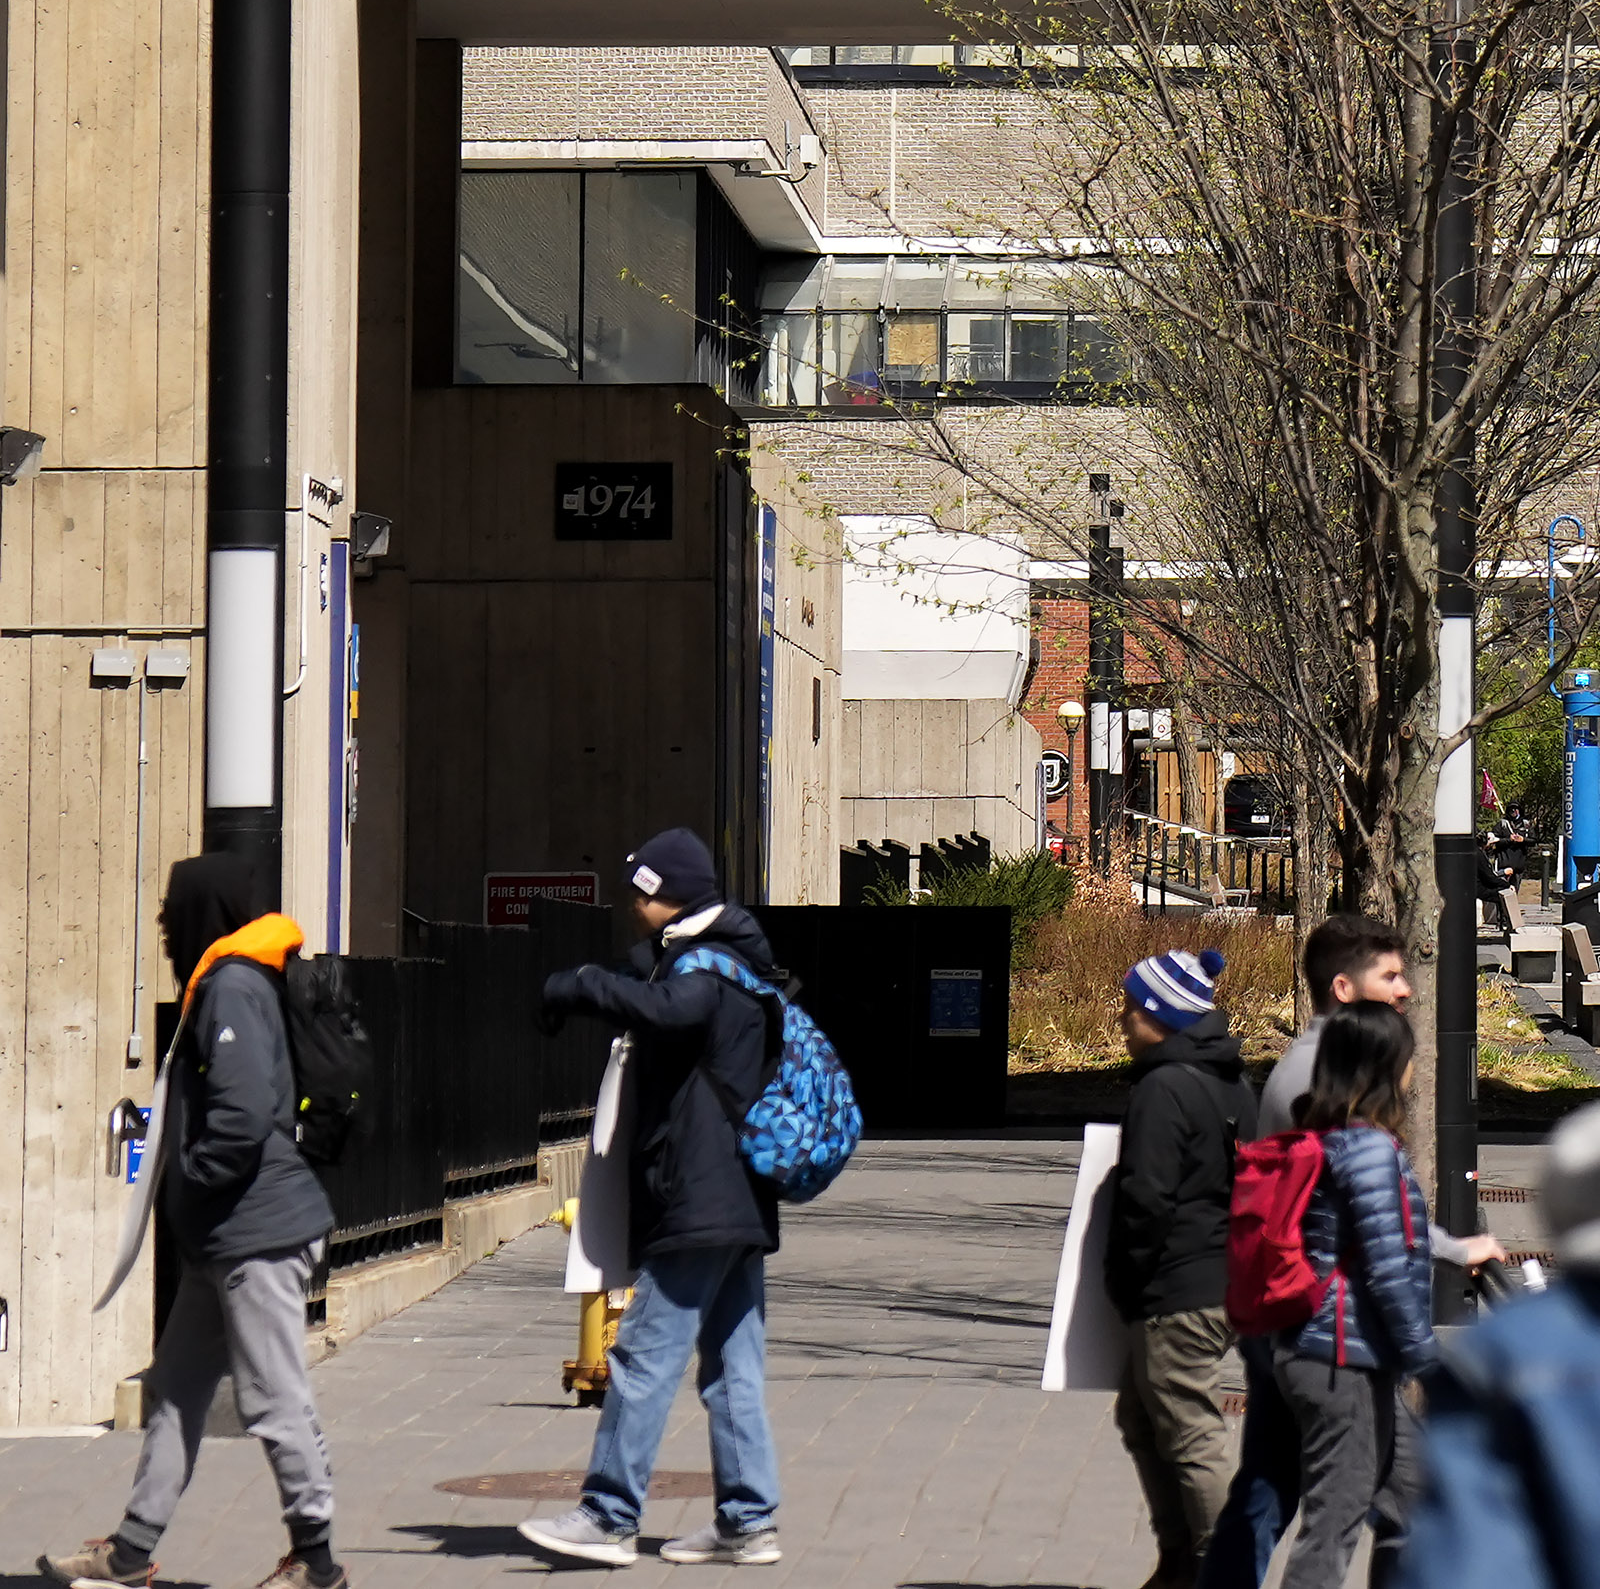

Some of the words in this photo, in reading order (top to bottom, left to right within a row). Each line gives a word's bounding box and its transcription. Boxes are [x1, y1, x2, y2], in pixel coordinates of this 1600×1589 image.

[573, 484, 657, 519] 1974
[1564, 750, 1577, 841] Emergency
[490, 886, 515, 898] FIRE
[518, 885, 593, 899] DEPARTMENT
[636, 871, 656, 889] CUPE
